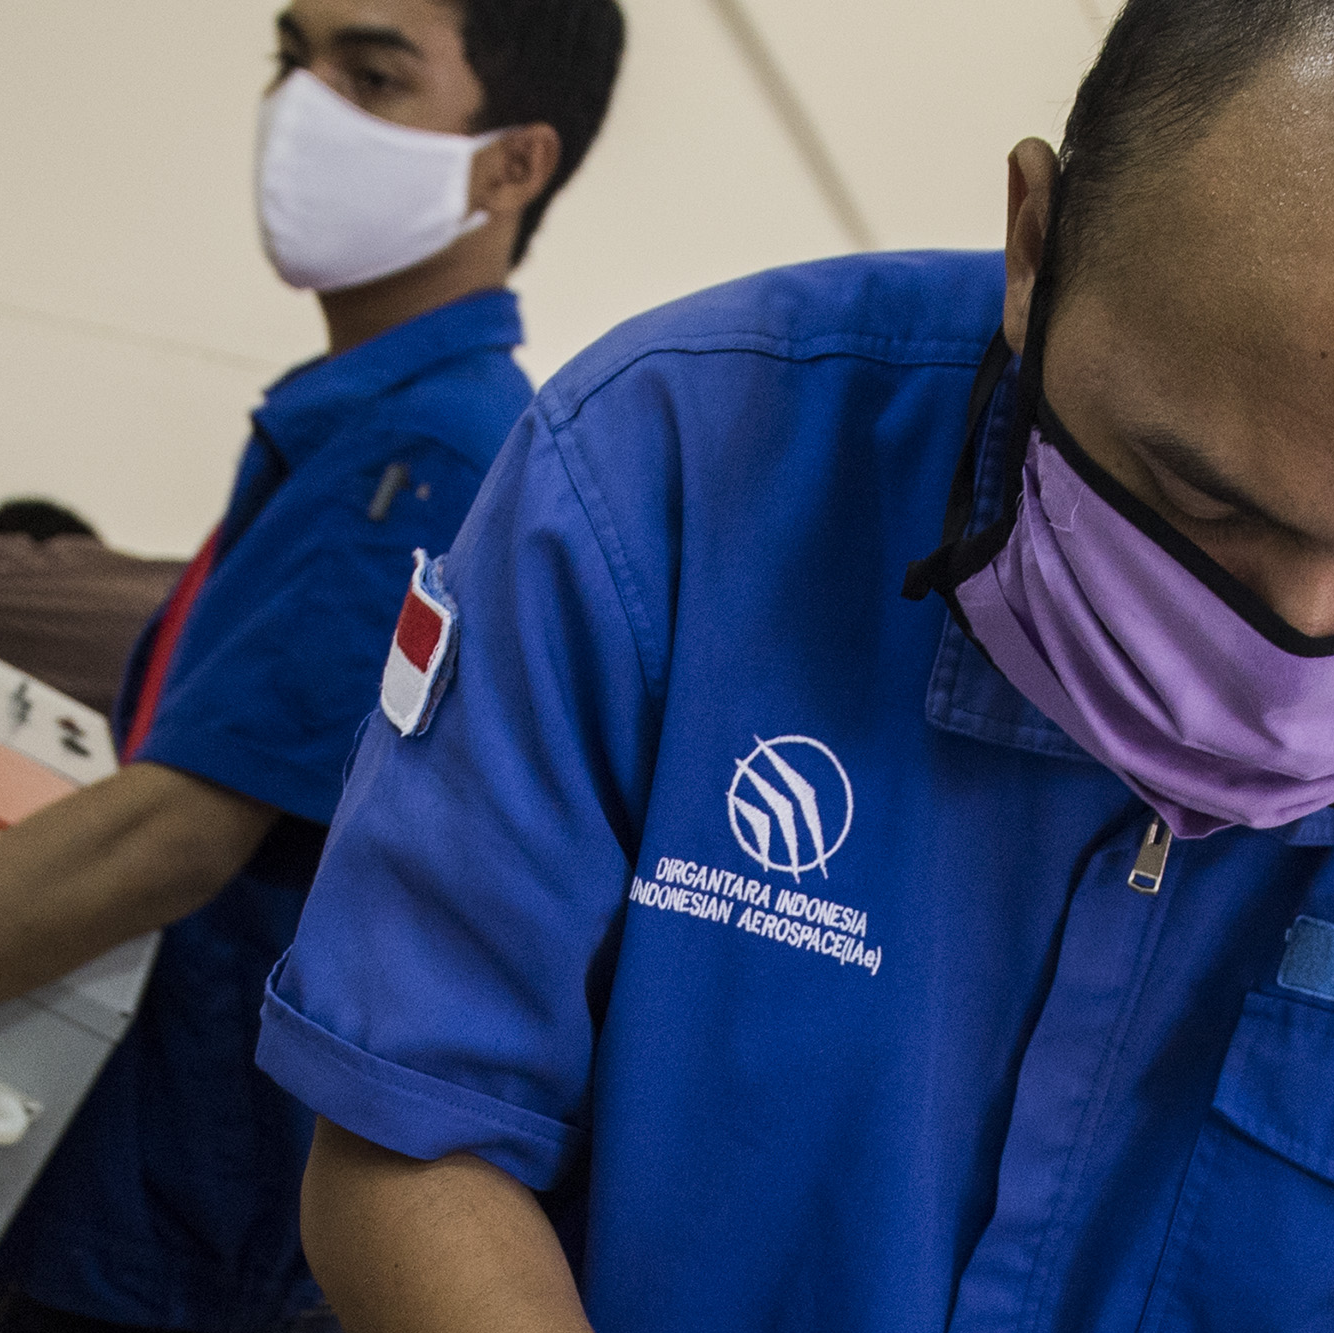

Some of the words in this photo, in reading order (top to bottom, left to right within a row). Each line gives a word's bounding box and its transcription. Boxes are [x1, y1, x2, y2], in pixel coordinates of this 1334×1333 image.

[629, 877, 734, 924] INDONESIAN
[656, 856, 771, 909] DIRGANTARA
[774, 889, 868, 937] INDONESIA
